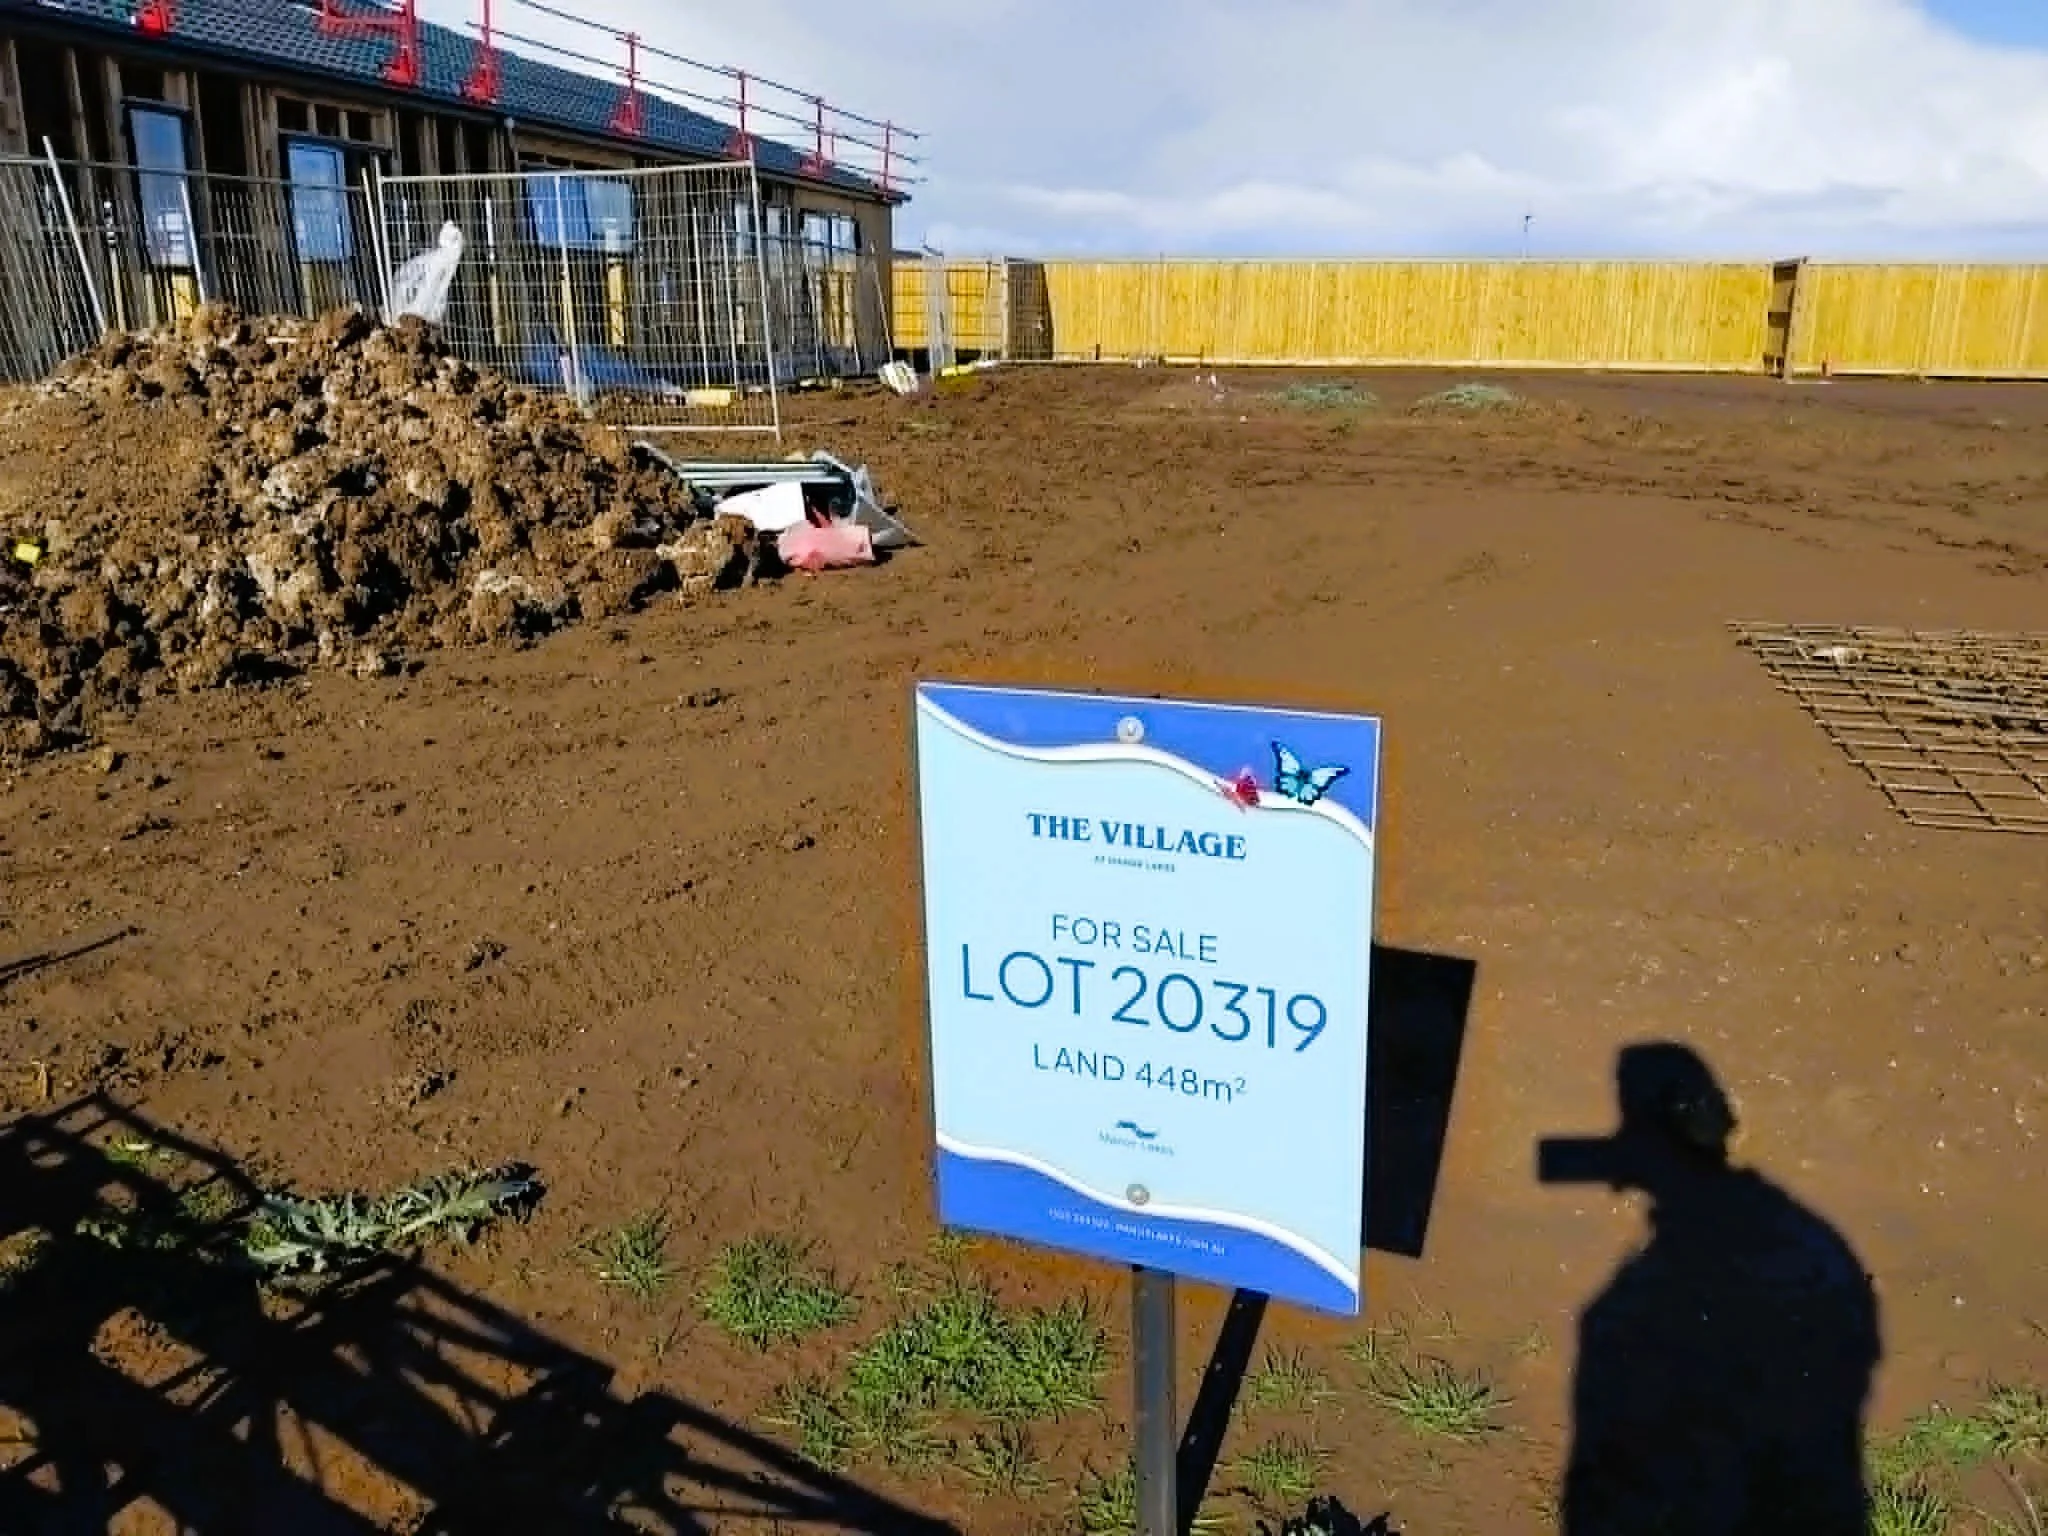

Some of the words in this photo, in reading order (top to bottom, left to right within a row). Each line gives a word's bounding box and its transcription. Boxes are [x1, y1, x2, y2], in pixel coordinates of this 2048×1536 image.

[1027, 812, 1091, 841] THE
[1100, 819, 1247, 860] VILLAGE
[1052, 914, 1122, 950] FOR
[1132, 924, 1218, 963] SALE
[962, 943, 1096, 1016] LOT
[1111, 965, 1328, 1053] 20319
[1033, 1043, 1126, 1082] LAND
